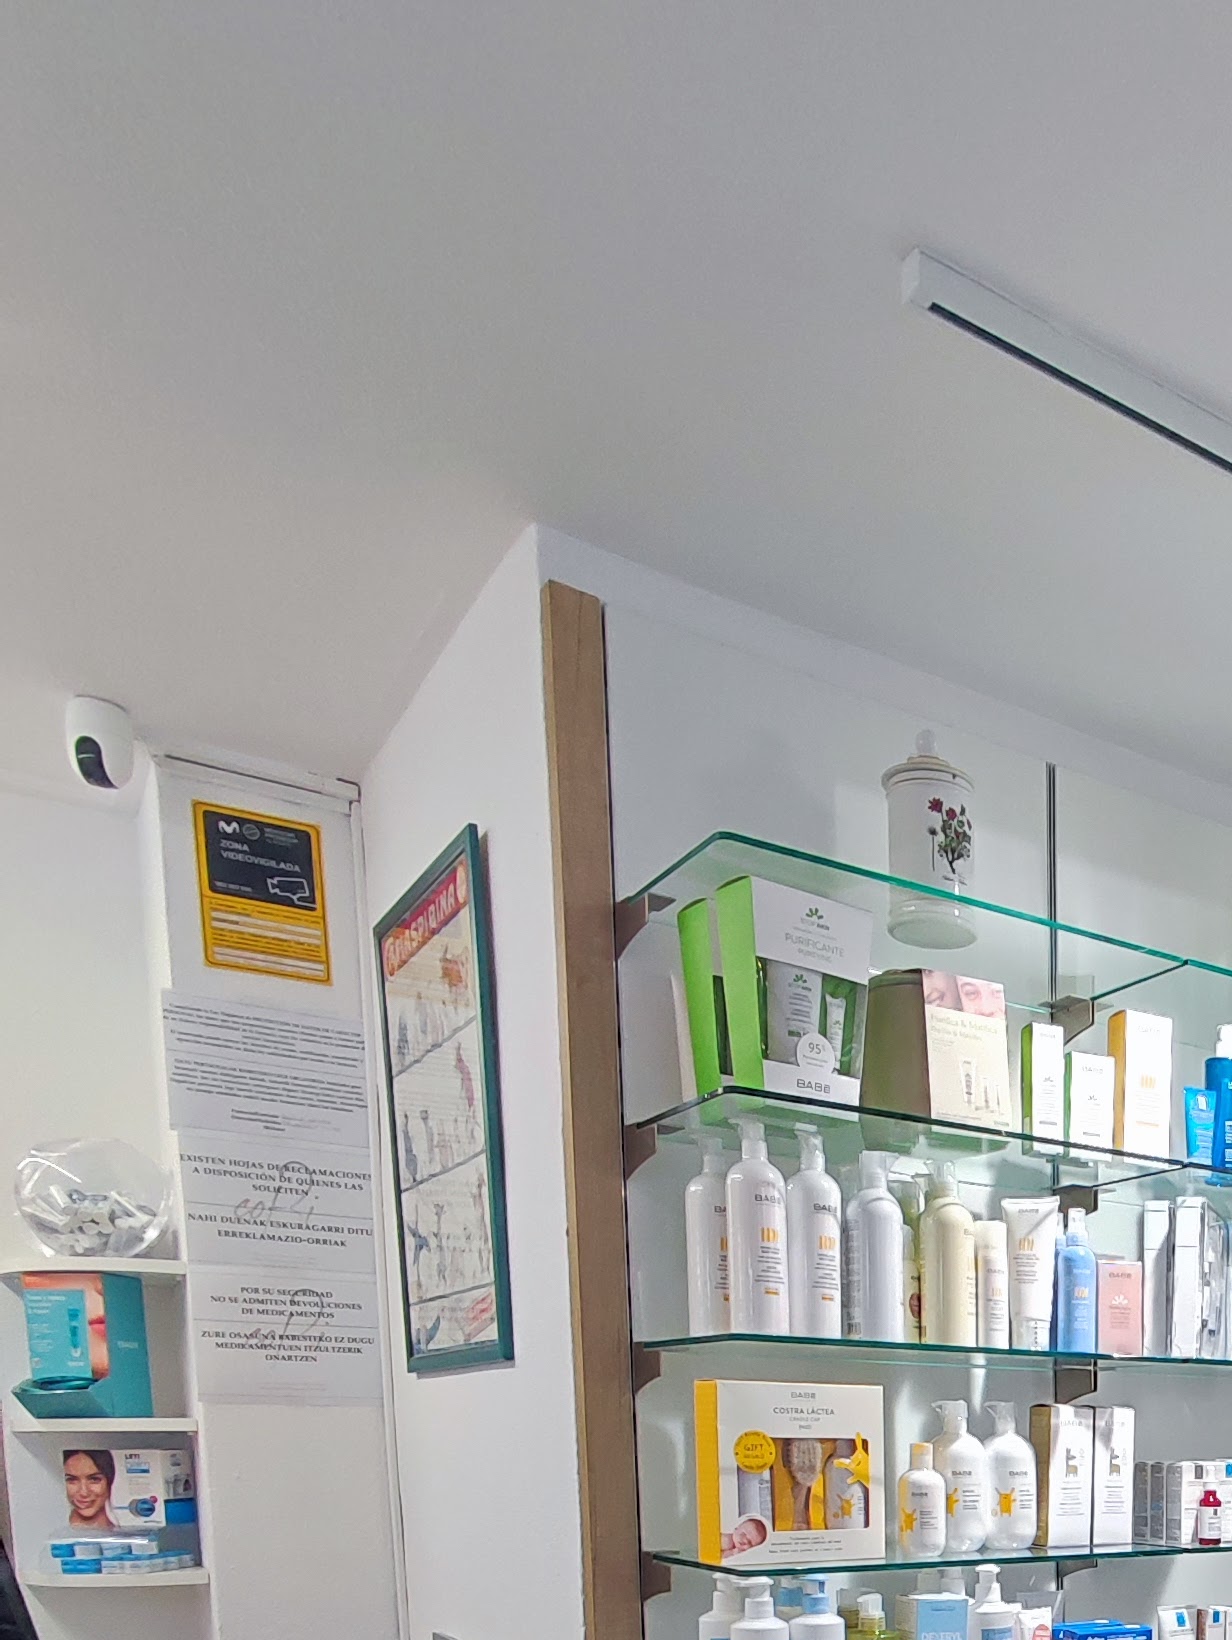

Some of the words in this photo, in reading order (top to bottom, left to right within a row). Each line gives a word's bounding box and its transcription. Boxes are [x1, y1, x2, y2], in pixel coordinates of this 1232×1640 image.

[219, 838, 250, 852] ZONA
[221, 850, 301, 872] VIDEOVIGILADA
[785, 932, 845, 958] PURIFICANTE
[180, 1154, 226, 1166] EXISTEN
[229, 1159, 264, 1171] HOJAS
[267, 1163, 281, 1172] DE
[283, 1164, 371, 1181] RECLAMACIONES
[192, 1167, 200, 1175] A
[203, 1167, 276, 1182] DISPOSICIÓN
[279, 1174, 293, 1183] DE
[295, 1176, 342, 1189] QUIENES
[344, 1182, 364, 1192] LAS
[252, 1184, 309, 1197] SOLICITEN
[188, 1212, 217, 1223] NAHI
[220, 1215, 267, 1227] DUENAK
[270, 1220, 344, 1234] ESKURAGARRI
[217, 1229, 347, 1247] ERREKLAMAZIO-ORRIAK
[240, 1287, 260, 1295] POR
[277, 1288, 333, 1299] SEGURIDAD
[210, 1295, 226, 1303] NO
[228, 1296, 239, 1304] SE
[241, 1297, 287, 1307] ADMITEN
[289, 1299, 362, 1310] DEVOLUCIONES
[241, 1307, 254, 1315] DE
[256, 1308, 335, 1319] MEDICAMENTOS
[201, 1330, 226, 1339] ZURE
[334, 1336, 346, 1344] EZ
[347, 1336, 375, 1345] DUGU
[265, 1354, 318, 1362] ONARTZEN
[773, 1407, 804, 1416] COSTRA
[806, 1406, 835, 1416] LÁCTEA
[744, 1443, 763, 1452] GIFT
